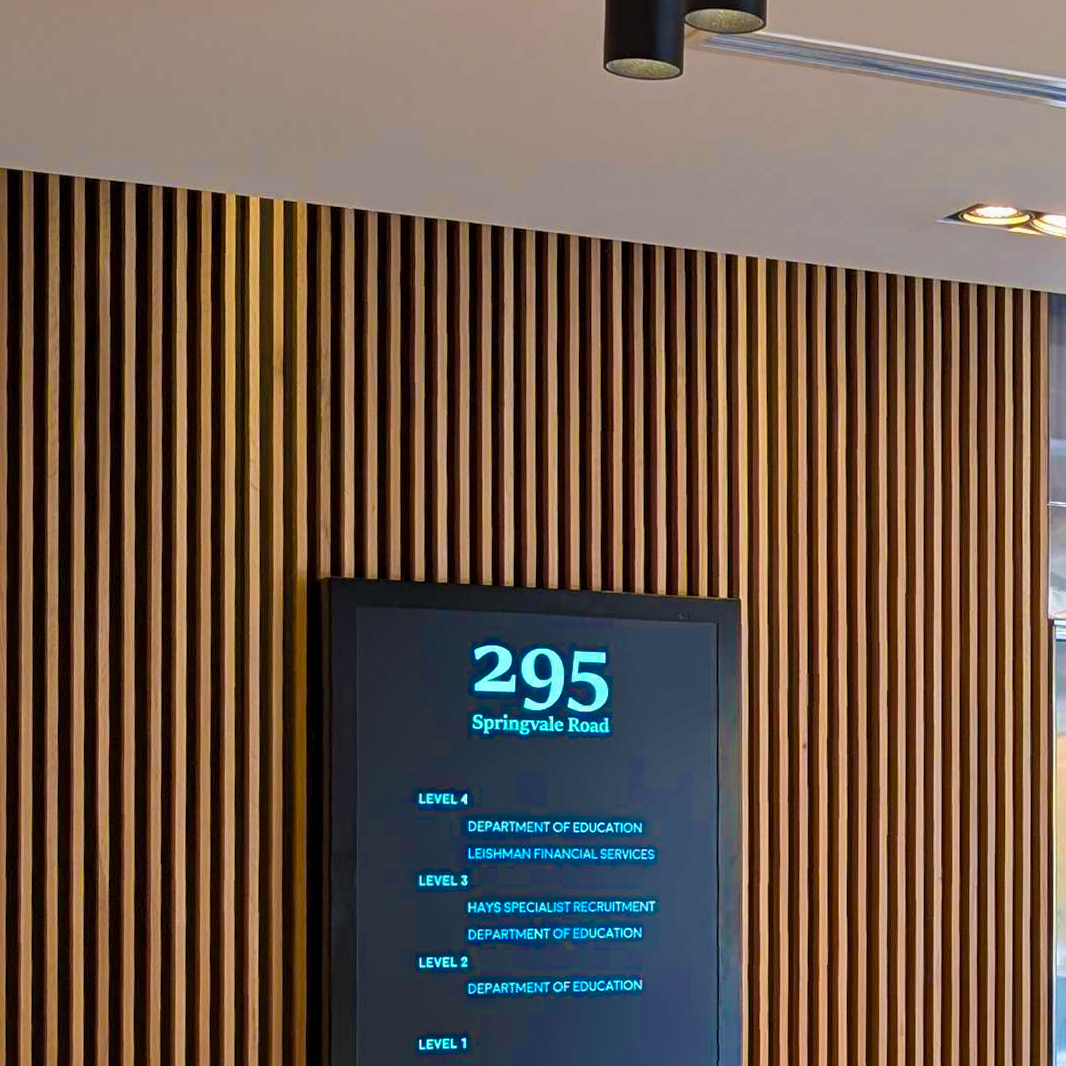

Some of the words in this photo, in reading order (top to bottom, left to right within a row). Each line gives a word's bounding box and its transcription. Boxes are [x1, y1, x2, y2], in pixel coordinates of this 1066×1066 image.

[473, 644, 609, 713] 295
[472, 714, 563, 734] Springvale
[567, 717, 610, 733] Road
[418, 792, 459, 806] LEVEL
[460, 792, 469, 806] 4
[467, 819, 551, 834] DEPARTMENT
[552, 821, 571, 834] OF
[572, 821, 643, 835] EDUCATION
[467, 847, 532, 860] LEISHMAN
[533, 848, 599, 860] FINANCIAL
[599, 848, 656, 861] SERVICES
[418, 874, 459, 888] LEVEL
[460, 874, 469, 888] 3
[467, 901, 502, 914] HAYS
[503, 900, 572, 914] SPECIALIST
[573, 900, 656, 914] RECRUITMENT
[467, 928, 551, 941] DEPARTMENT
[552, 927, 571, 940] OF
[572, 927, 643, 940] EDUCATION
[418, 956, 459, 969] LEVEL
[460, 955, 469, 969] 2
[467, 981, 551, 995] DEPARTMENT
[552, 980, 571, 993] OF
[572, 979, 643, 993] EDUCATION
[418, 1037, 458, 1051] LEVEL
[460, 1036, 467, 1050] 1
